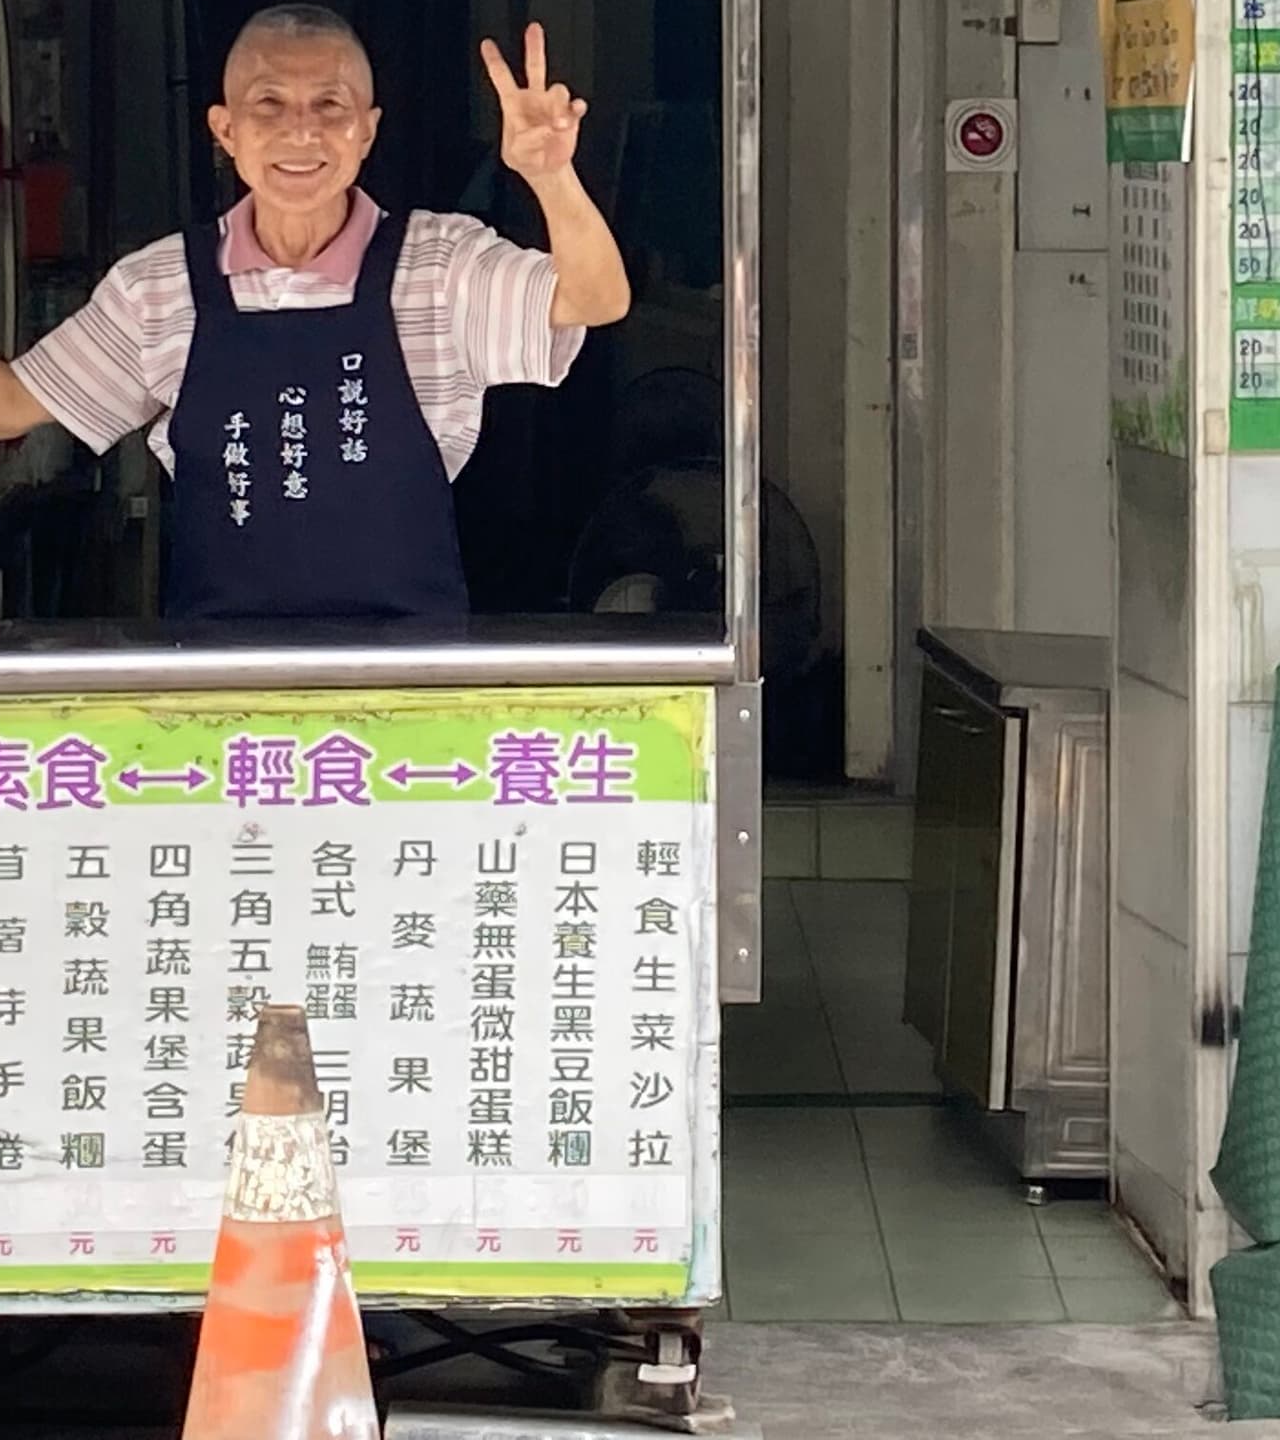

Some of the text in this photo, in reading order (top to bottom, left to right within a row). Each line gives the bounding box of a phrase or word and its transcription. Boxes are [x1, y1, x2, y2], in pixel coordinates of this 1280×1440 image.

[277, 386, 309, 499] 心想好意
[225, 735, 373, 808] 輕食
[489, 733, 634, 805] 養生
[311, 840, 357, 918] 各式
[59, 845, 111, 1169] 五穀蔬果飯糰
[142, 843, 192, 1169] 四角蔬果堡含蛋
[386, 839, 437, 1167] 丹麥蔬果堡
[466, 839, 519, 1168] 山藥無蛋微甜蛋糕
[547, 841, 598, 1168] 日本養生黑豆飯糰
[628, 840, 681, 1168] 輕食生菜沙拉
[69, 1233, 95, 1257] 元
[151, 1232, 177, 1255] 元
[395, 1229, 421, 1253] 元
[476, 1229, 502, 1253] 元
[557, 1229, 583, 1253] 元
[632, 1229, 659, 1253] 元
